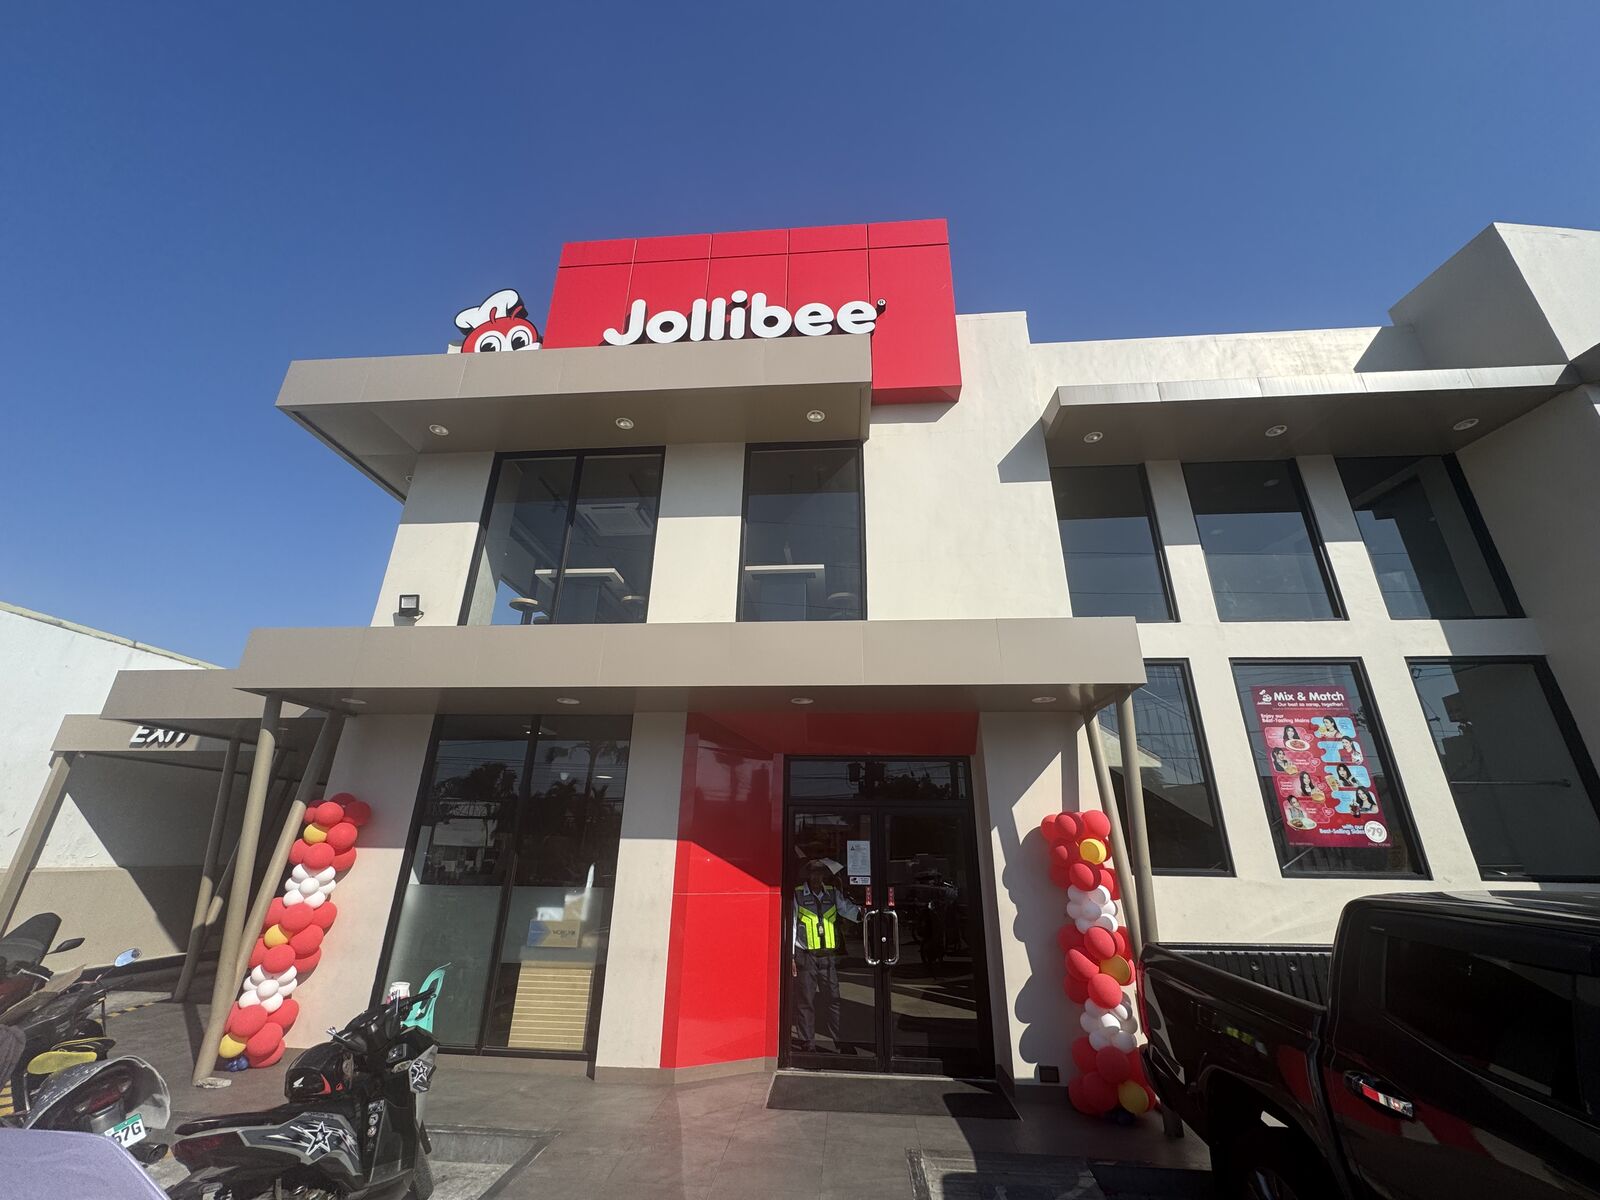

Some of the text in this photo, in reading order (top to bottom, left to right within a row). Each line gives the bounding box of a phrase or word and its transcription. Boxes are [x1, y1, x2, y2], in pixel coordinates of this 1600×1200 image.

[603, 290, 877, 345] Jollibee
[1273, 691, 1345, 701] Mix & Match
